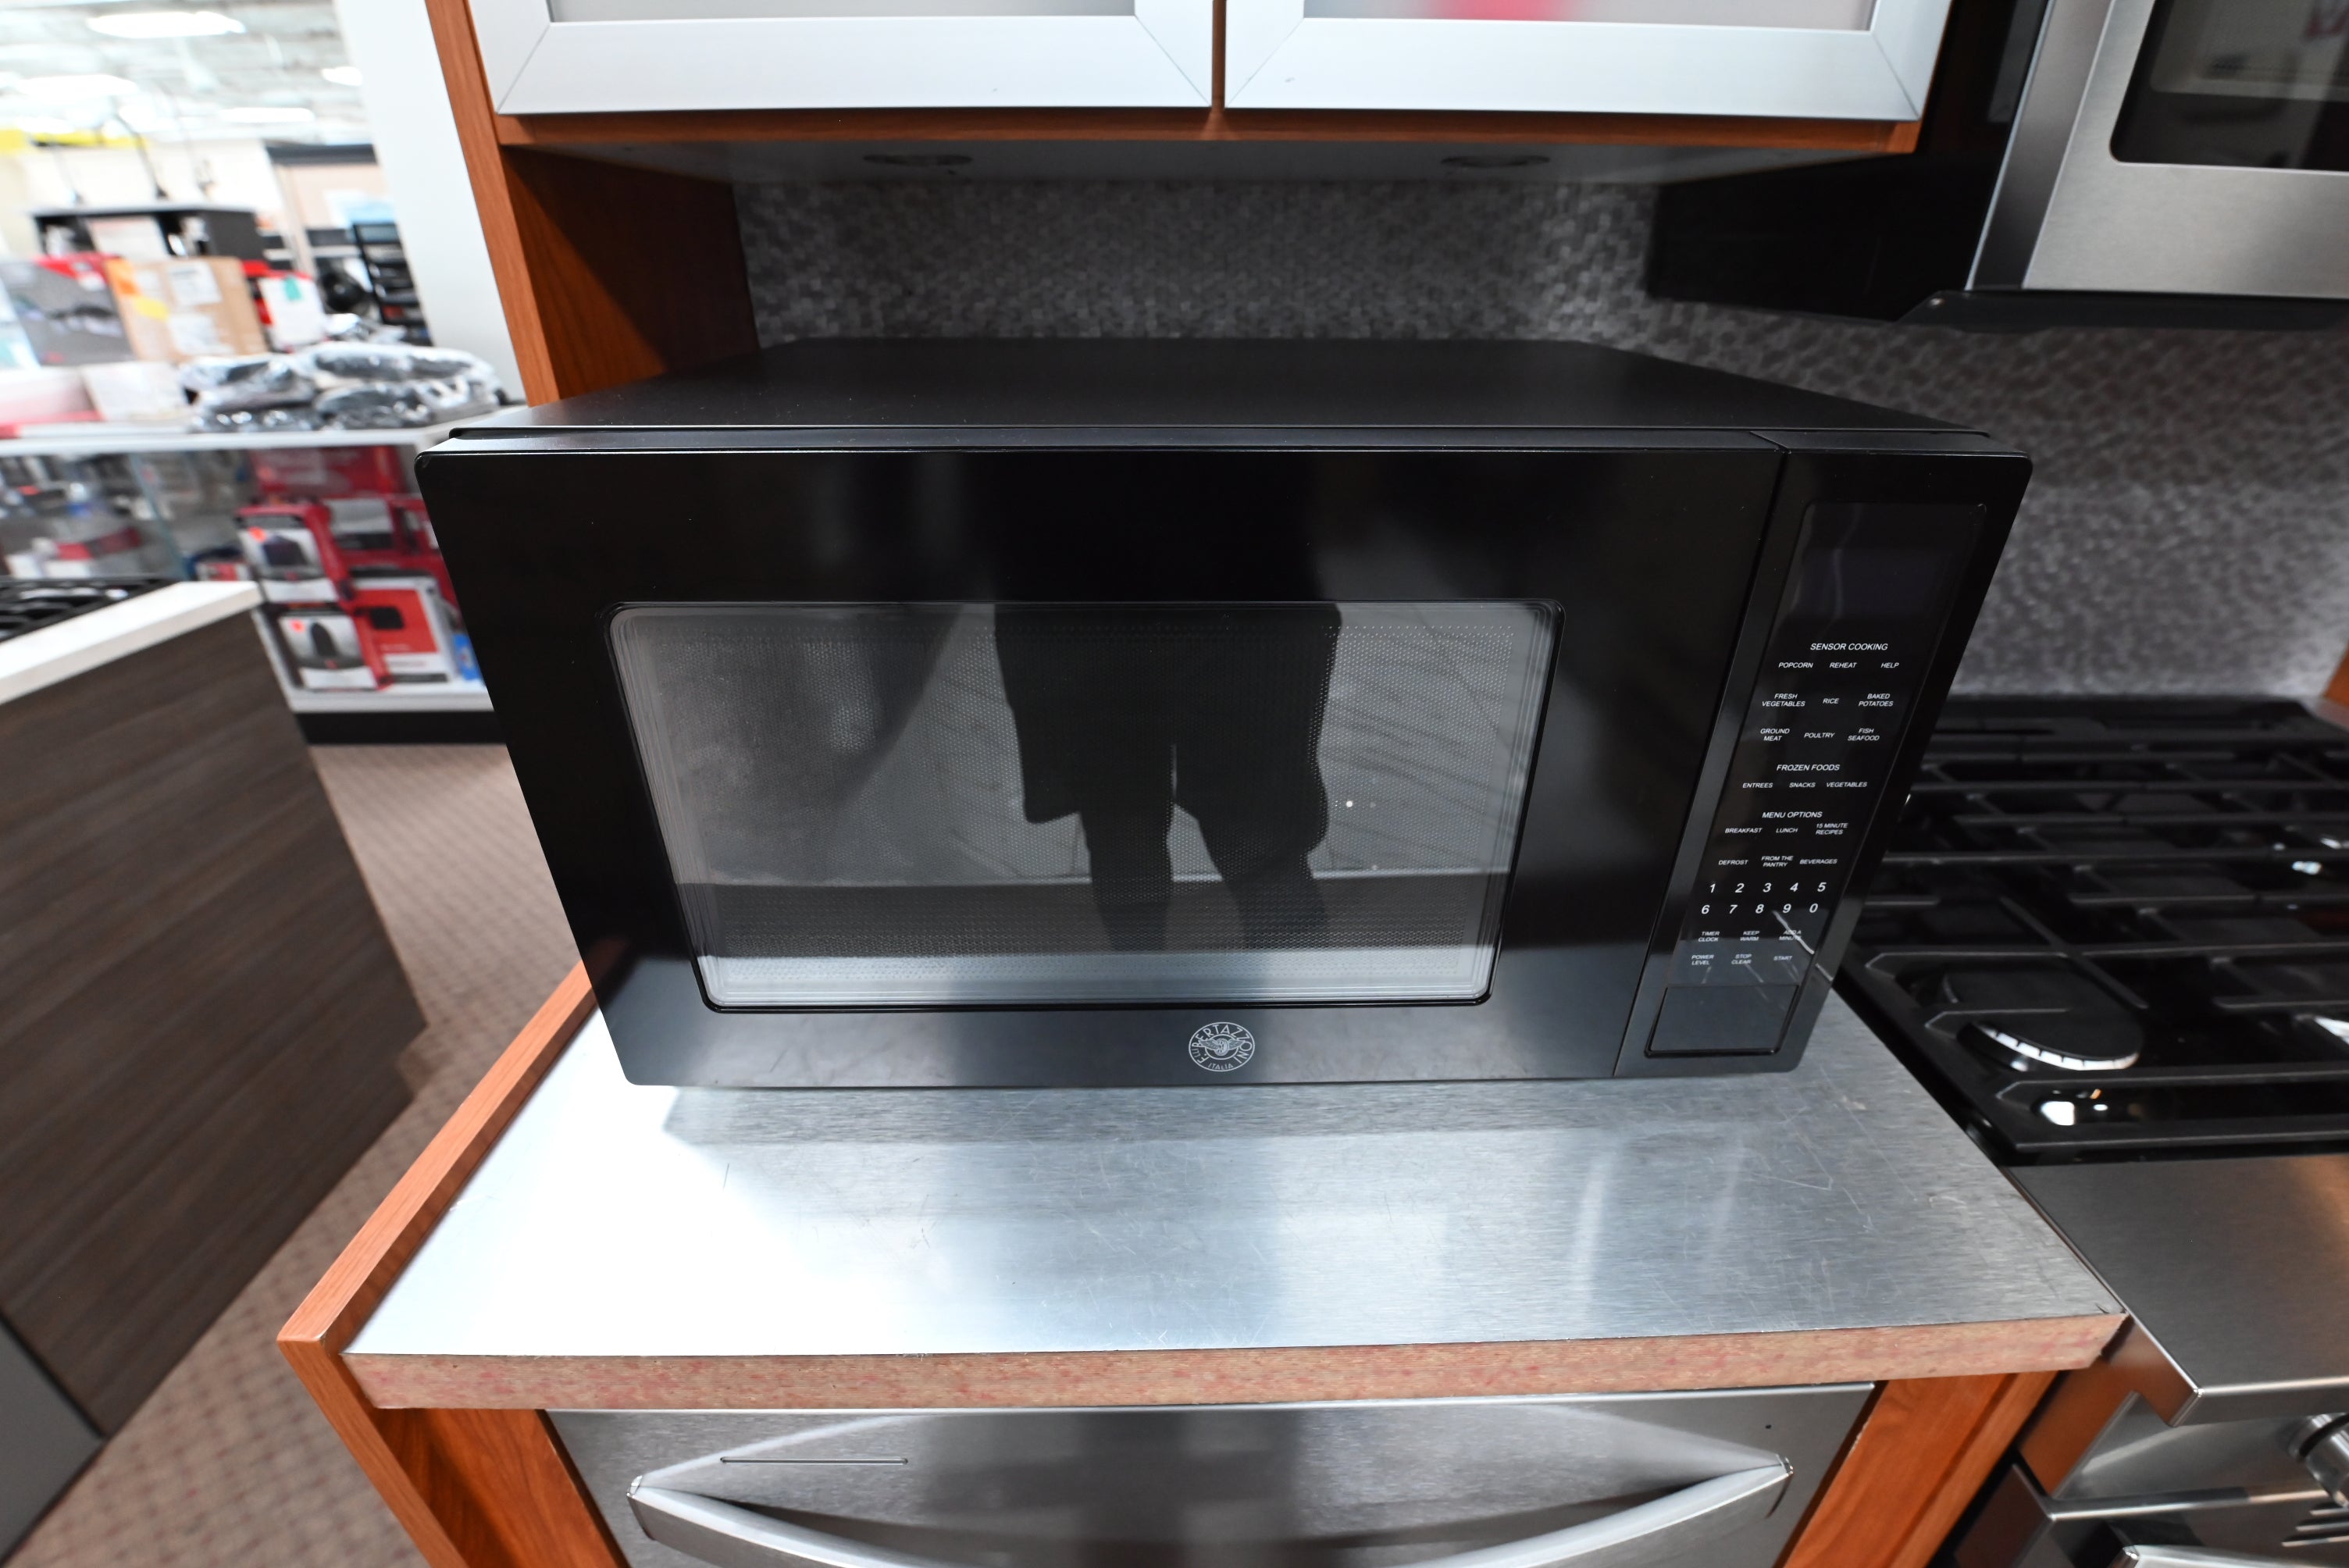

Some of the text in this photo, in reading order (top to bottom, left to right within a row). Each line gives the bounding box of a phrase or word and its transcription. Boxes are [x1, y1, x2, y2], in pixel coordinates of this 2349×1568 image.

[1709, 883, 1716, 893] 1
[1735, 883, 1745, 893] 2
[1763, 882, 1772, 893] 3
[1790, 882, 1799, 893] 4
[1817, 882, 1827, 892] 5
[1702, 905, 1710, 914] 6
[1729, 904, 1738, 914] 7
[1756, 904, 1764, 914] 8
[1783, 903, 1791, 913] 9
[1809, 903, 1819, 913] 0
[1192, 1025, 1252, 1064] BERTAZZONI
